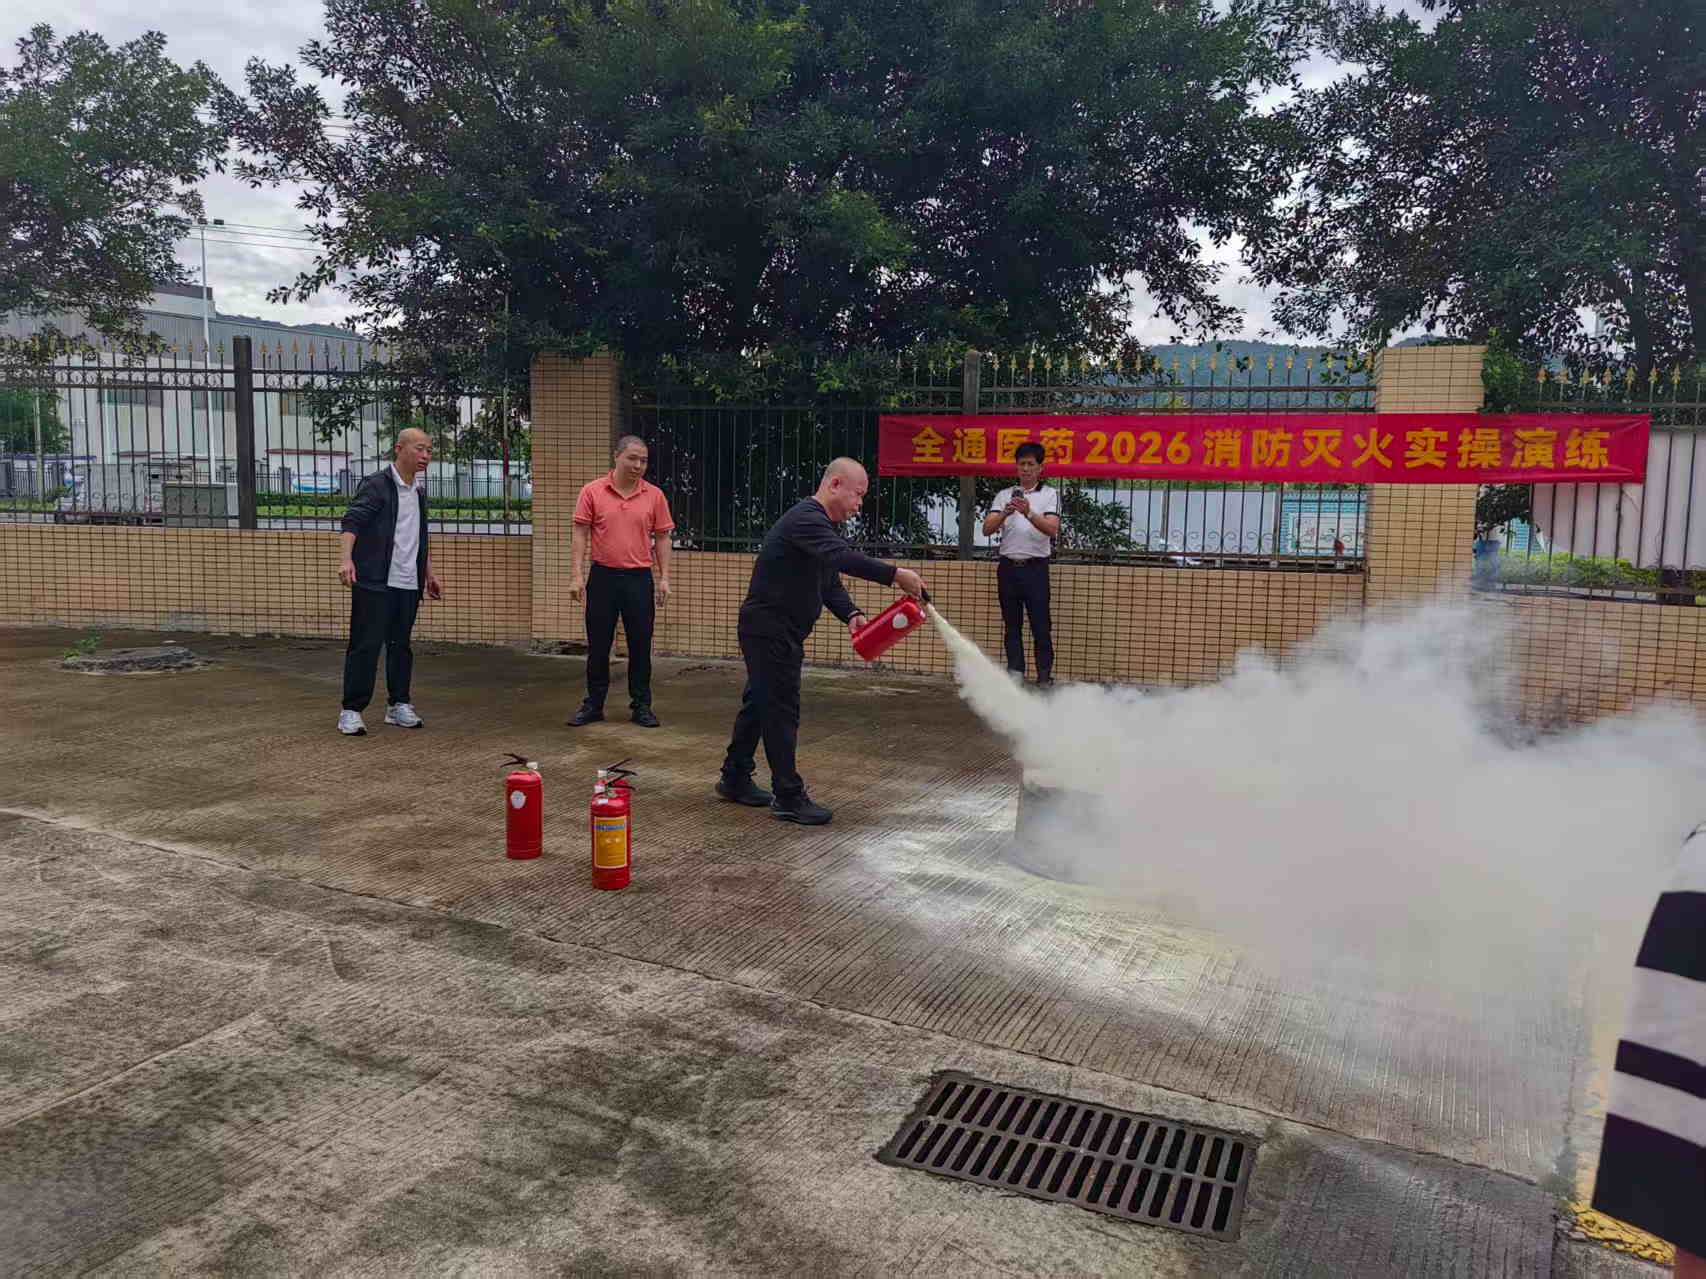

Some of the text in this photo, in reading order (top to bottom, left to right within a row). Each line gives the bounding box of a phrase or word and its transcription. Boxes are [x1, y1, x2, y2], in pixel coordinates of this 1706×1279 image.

[911, 424, 1610, 470] 全通医药2026消防灭火实操演练
